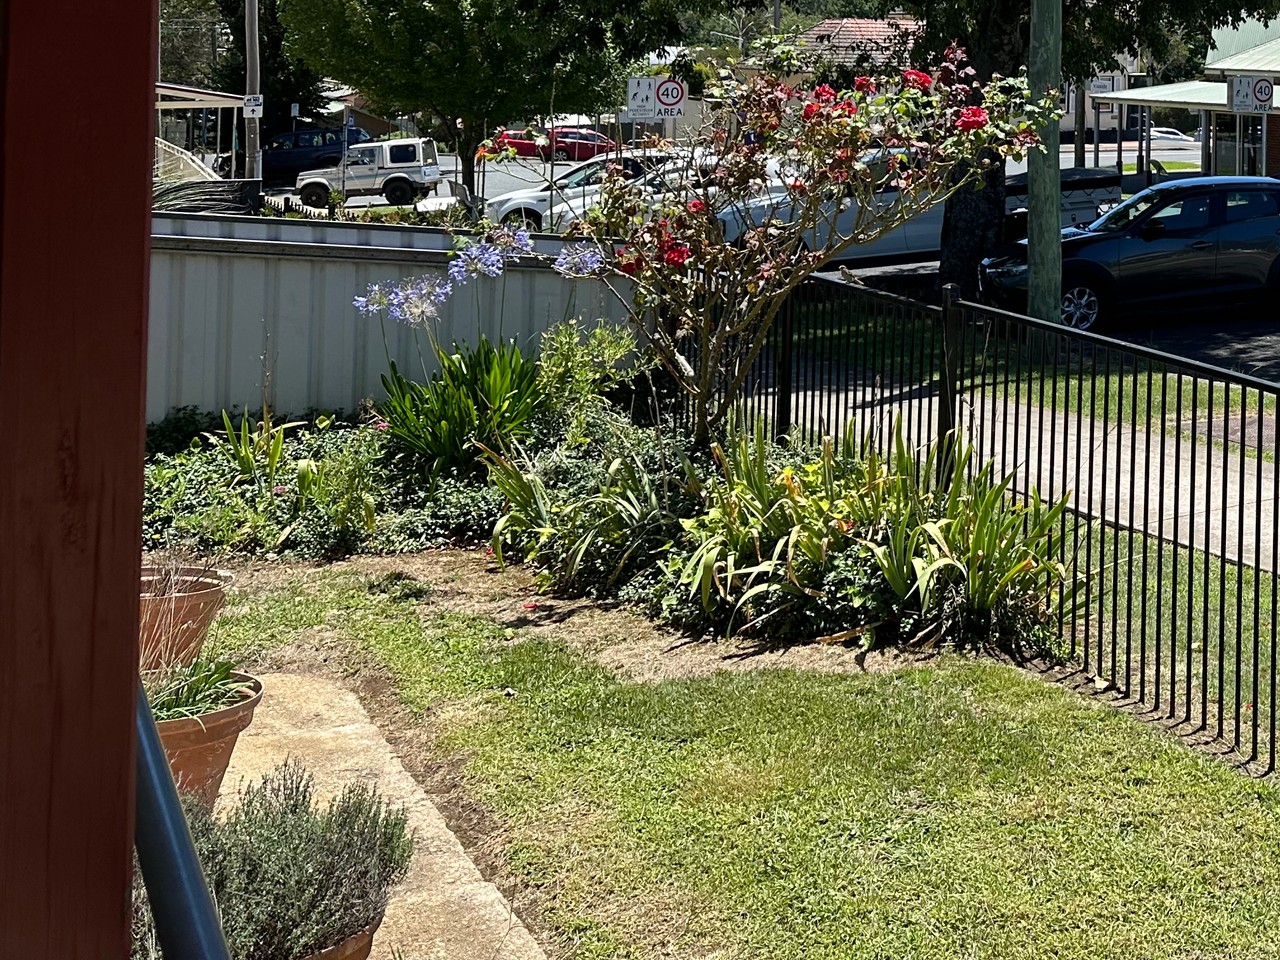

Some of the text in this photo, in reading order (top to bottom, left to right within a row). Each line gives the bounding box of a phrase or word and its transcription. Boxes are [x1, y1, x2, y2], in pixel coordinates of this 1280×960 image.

[661, 87, 680, 99] 40
[1257, 85, 1270, 96] 40
[656, 108, 683, 116] AREA
